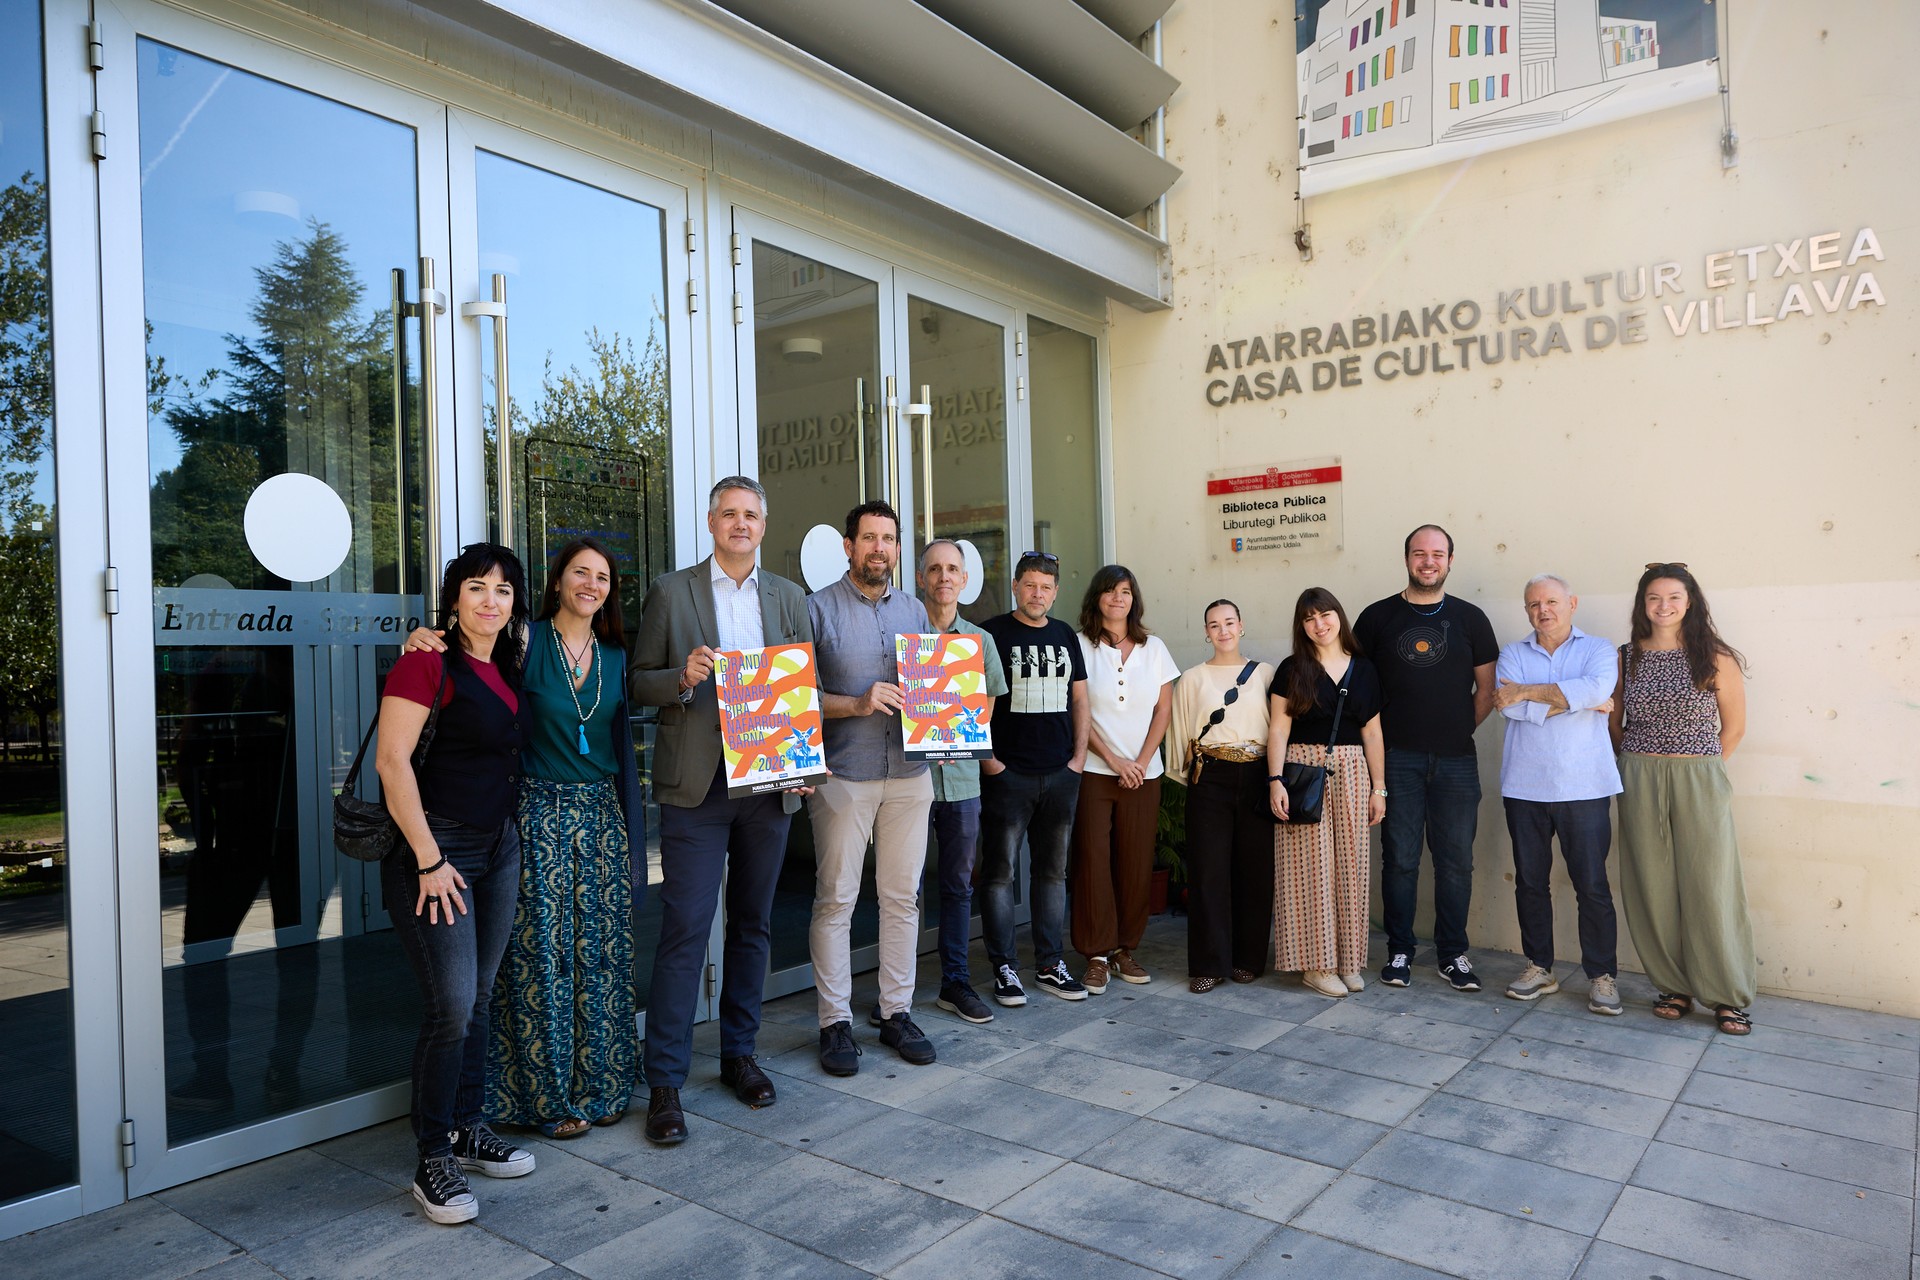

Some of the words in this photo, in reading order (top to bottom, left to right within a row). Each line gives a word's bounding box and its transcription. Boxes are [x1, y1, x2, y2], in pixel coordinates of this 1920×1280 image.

[1205, 300, 1481, 374] ATARRABIAKO
[1499, 261, 1684, 323] KULTUR
[1705, 227, 1886, 289] ETXEA
[1205, 366, 1302, 407] CASA
[1312, 355, 1362, 391] DE
[1374, 321, 1573, 381] CULTURA
[1585, 308, 1648, 350] DE
[1663, 272, 1886, 337] VILLAVA
[1228, 477, 1263, 486] Nafarroako
[1281, 472, 1312, 481] Gobierno
[1292, 477, 1318, 486] Navarra
[1232, 483, 1263, 492] Gobernua
[560, 490, 571, 500] de
[1222, 500, 1279, 514] Biblioteca
[1283, 494, 1326, 508] Pública
[616, 509, 641, 520] etxea
[1223, 515, 1275, 530] Liburutegi
[1279, 512, 1327, 525] Publikoa
[1246, 534, 1287, 544] Ayuntamiento
[1246, 543, 1281, 551] Atarrabiako
[1283, 541, 1302, 549] Udala
[162, 603, 293, 632] Entrada
[900, 638, 943, 652] GIRANDO
[719, 653, 769, 673] GIRANDO
[902, 652, 920, 665] POR
[902, 665, 946, 679] NAVARRA
[721, 672, 744, 688] POR
[904, 678, 926, 692] BIRA
[723, 683, 773, 704] NAVARRA
[905, 691, 961, 705] NAFARROAN
[725, 702, 750, 720] BIRA
[906, 705, 939, 719] BARNA
[727, 711, 791, 735] NAFARROAN
[728, 731, 766, 751] BARNA
[931, 729, 956, 741] 2026
[758, 755, 786, 772] 2026
